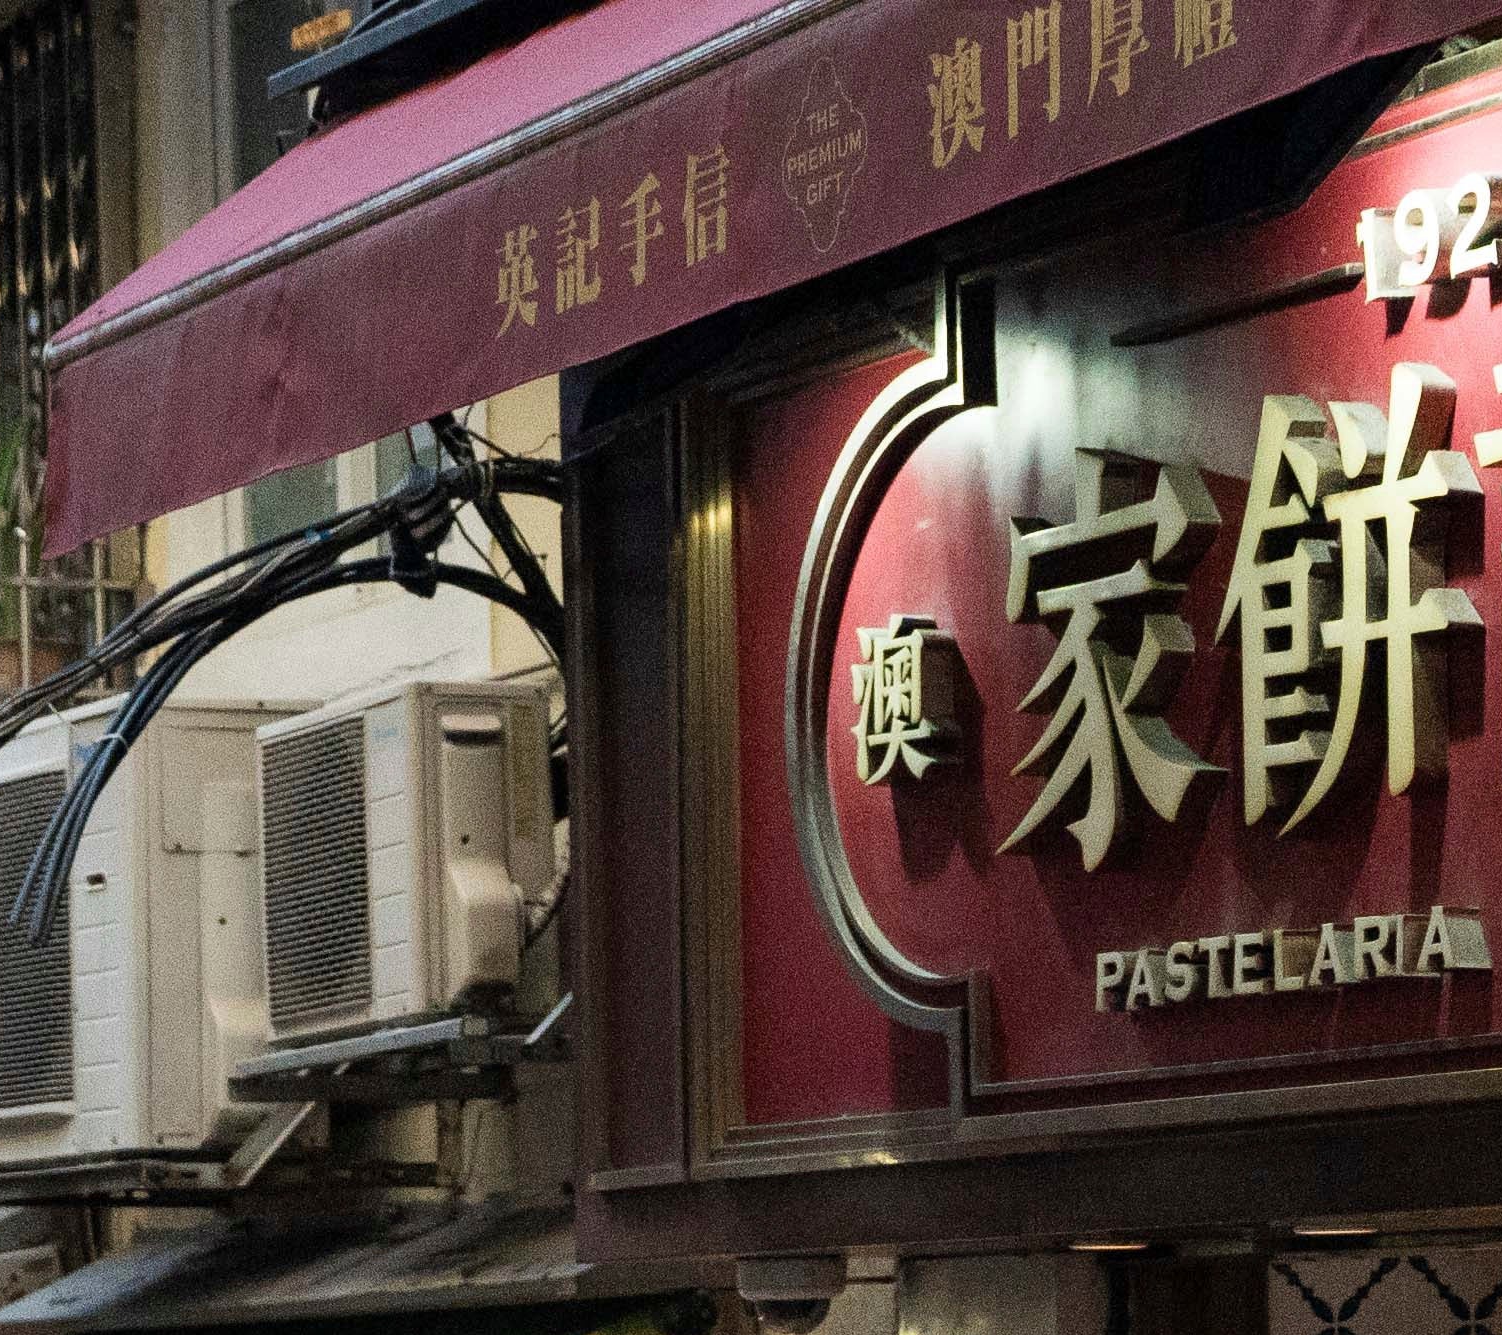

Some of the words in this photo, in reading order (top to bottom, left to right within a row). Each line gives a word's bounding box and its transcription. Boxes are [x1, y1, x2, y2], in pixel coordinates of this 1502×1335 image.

[806, 102, 839, 136] THE
[787, 128, 862, 181] PREMIUM
[806, 171, 844, 206] GIFT
[495, 145, 732, 339] 英記手信
[1095, 905, 1466, 1011] PASTELARIA
